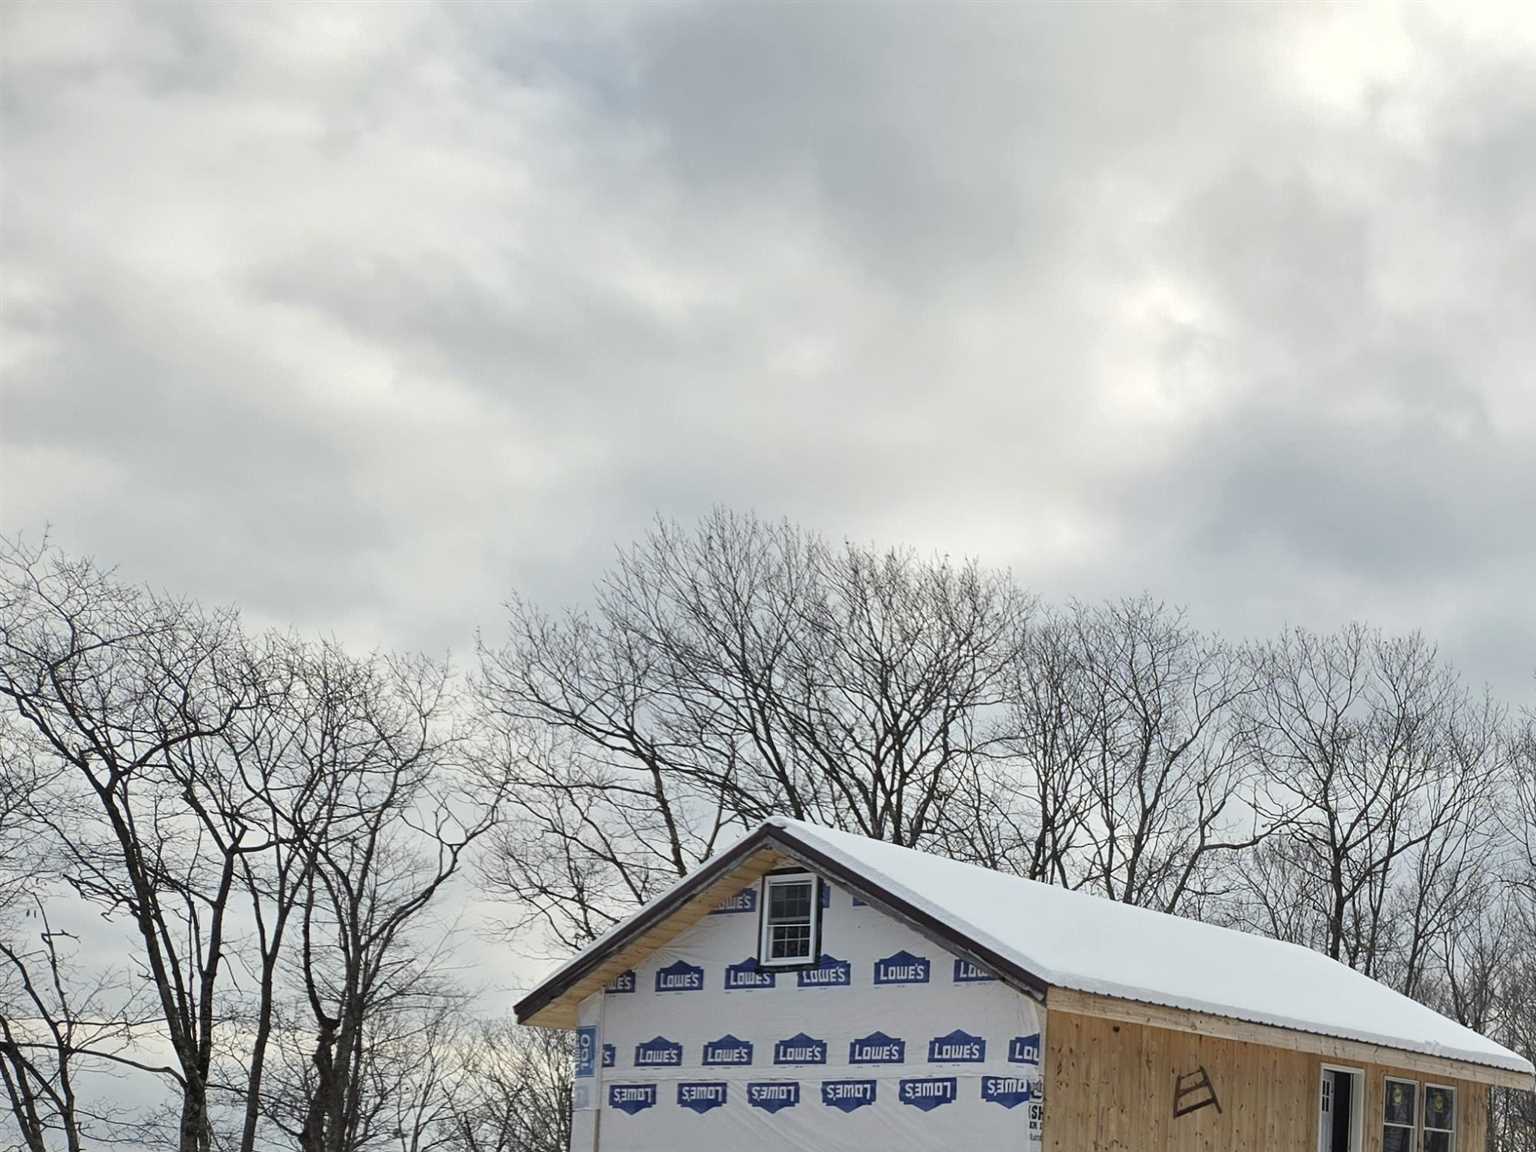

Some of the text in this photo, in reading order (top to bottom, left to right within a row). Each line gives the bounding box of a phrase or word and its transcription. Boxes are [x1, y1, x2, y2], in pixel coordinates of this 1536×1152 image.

[659, 971, 699, 988] LOWE'S
[730, 969, 771, 986] LOWES
[803, 966, 846, 983] LOWE'S
[880, 962, 925, 981] LOWE'S
[639, 1047, 678, 1064] LOWE'S
[707, 1046, 748, 1062] LOWE'S
[779, 1045, 821, 1061] LOWE'S
[855, 1044, 900, 1060] LOWE'S
[934, 1042, 980, 1059] LOWE'S
[614, 1085, 651, 1103] LOWE'S
[682, 1085, 723, 1102] LOWE'S
[751, 1086, 795, 1102] LOWE'S
[826, 1083, 871, 1101] LOWE'S
[905, 1081, 951, 1099] LOWE'S
[987, 1079, 1028, 1096] OWE'S
